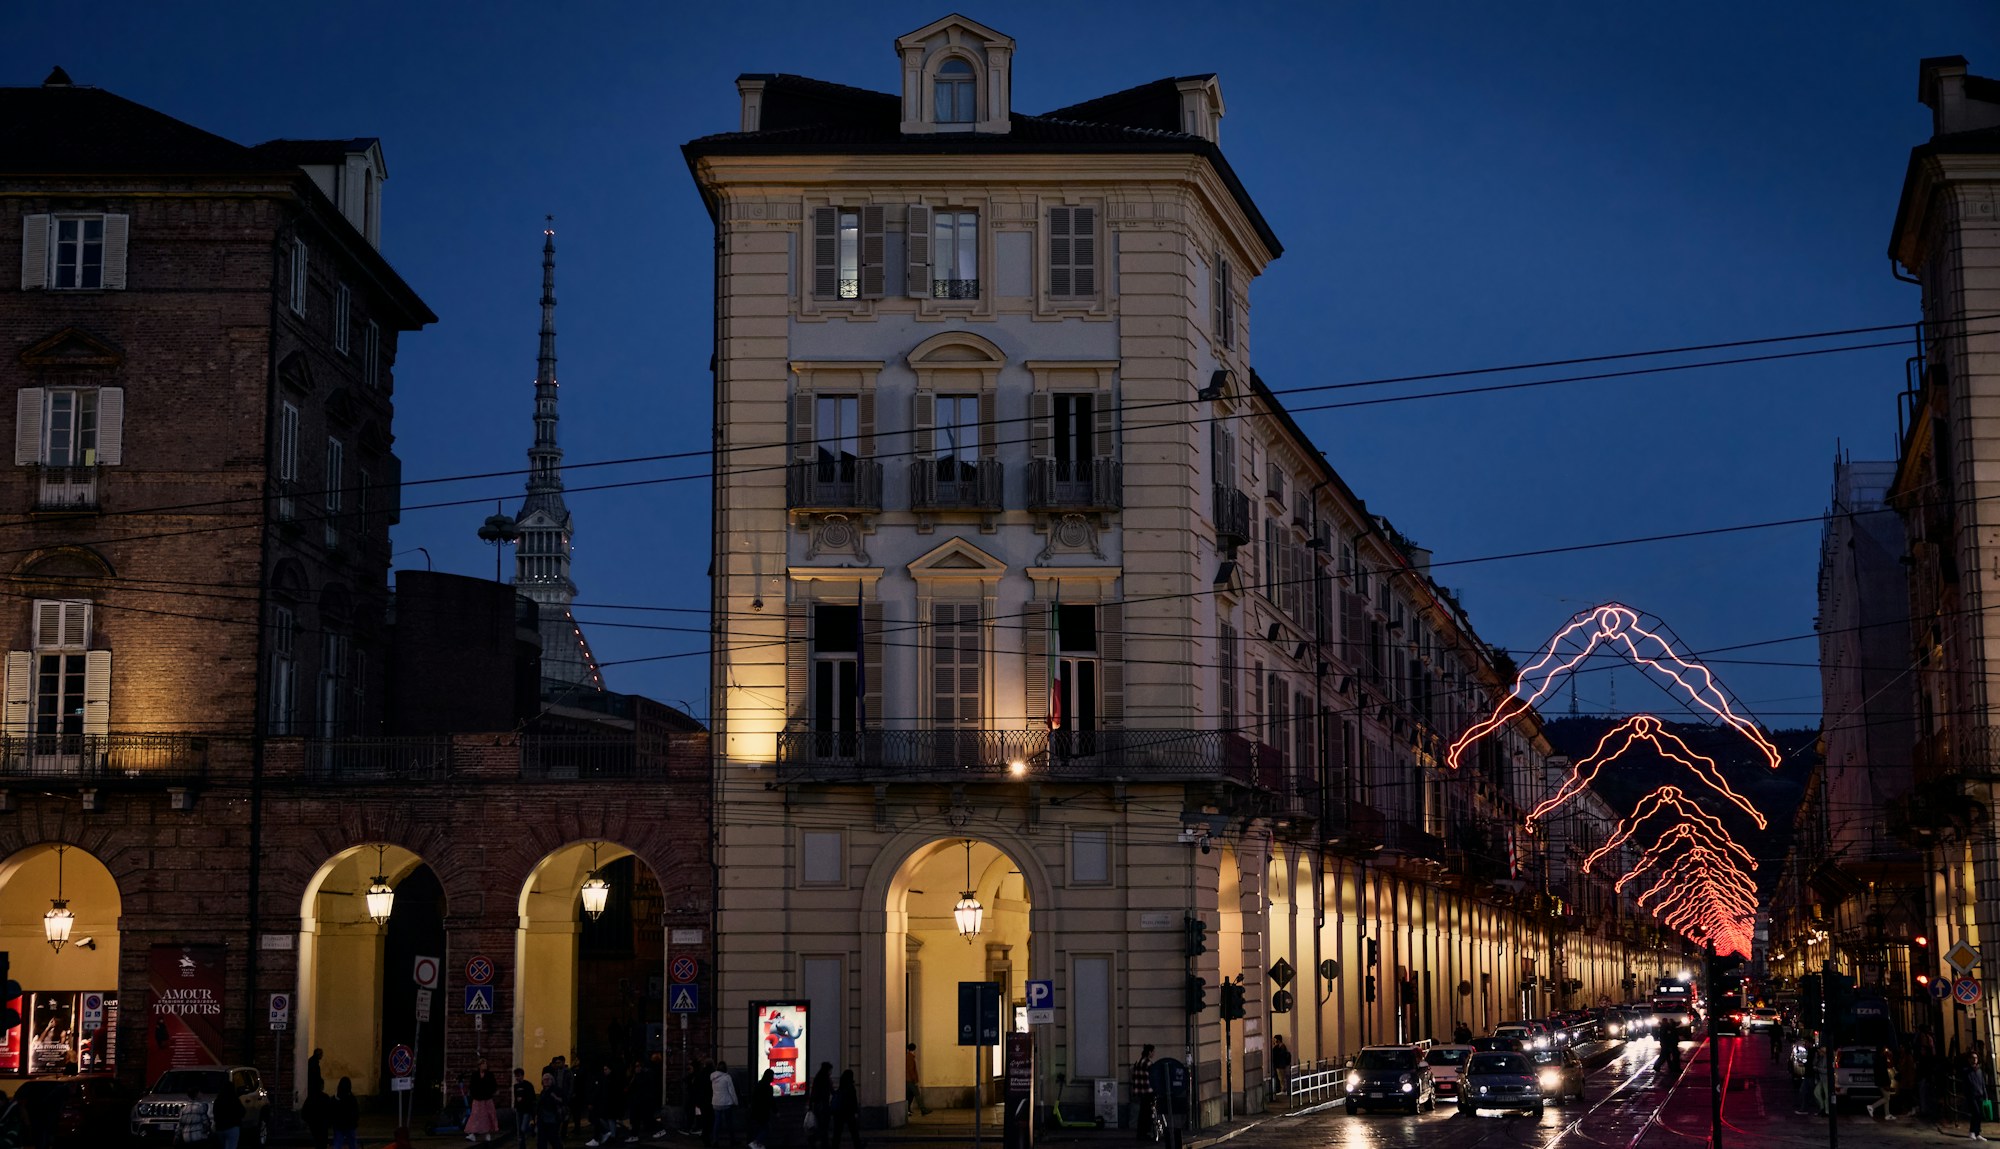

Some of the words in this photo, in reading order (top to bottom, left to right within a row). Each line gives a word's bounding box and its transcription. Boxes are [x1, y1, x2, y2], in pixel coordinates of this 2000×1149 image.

[162, 988, 212, 1000] AMOUR
[1031, 983, 1048, 1007] P
[152, 1003, 221, 1016] TOUJOURS
